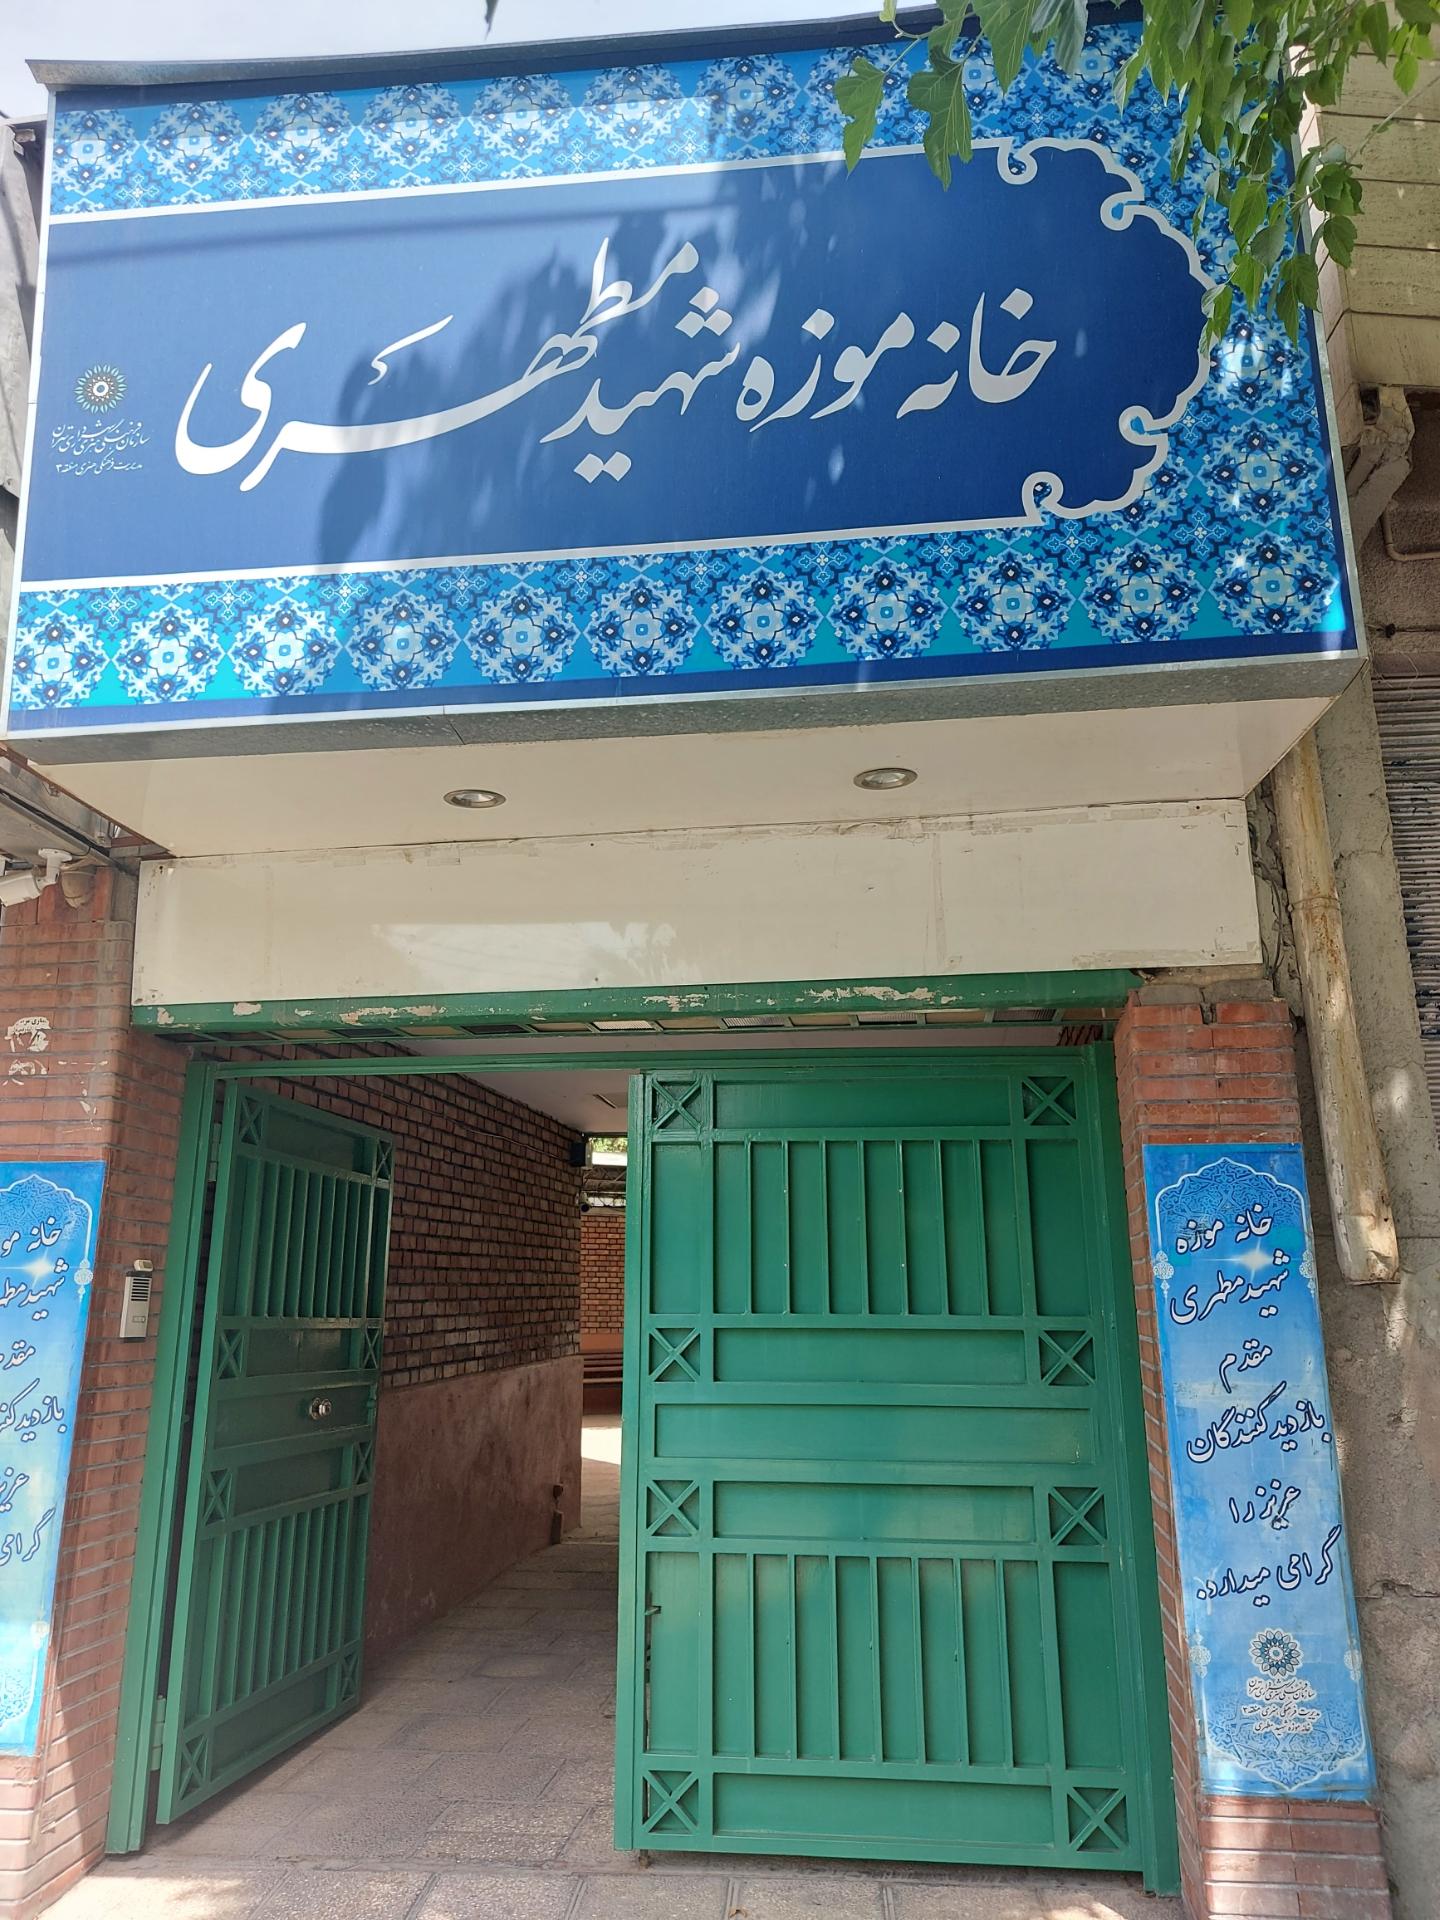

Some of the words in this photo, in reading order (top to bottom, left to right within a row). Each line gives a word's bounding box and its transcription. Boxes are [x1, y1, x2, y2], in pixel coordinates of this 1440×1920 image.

[174, 237, 699, 492] مطهری
[735, 308, 915, 431] موزه
[896, 288, 1057, 419] خانه
[540, 286, 742, 482] شهید
[115, 432, 151, 451] سازمان
[0, 1230, 20, 1258] مو
[26, 1216, 62, 1253] خانه
[1176, 1218, 1224, 1255] موزه
[1235, 1203, 1273, 1243] خانه
[0, 1276, 28, 1308] مطه
[18, 1257, 69, 1321] شهید
[1170, 1270, 1245, 1324] مطهری
[1240, 1249, 1291, 1318] شهید
[0, 1339, 36, 1371] مقد
[1219, 1338, 1273, 1393] مقدم
[1229, 1497, 1256, 1524] را
[1255, 1479, 1301, 1530] عزیز
[1276, 1524, 1343, 1590] گرامی
